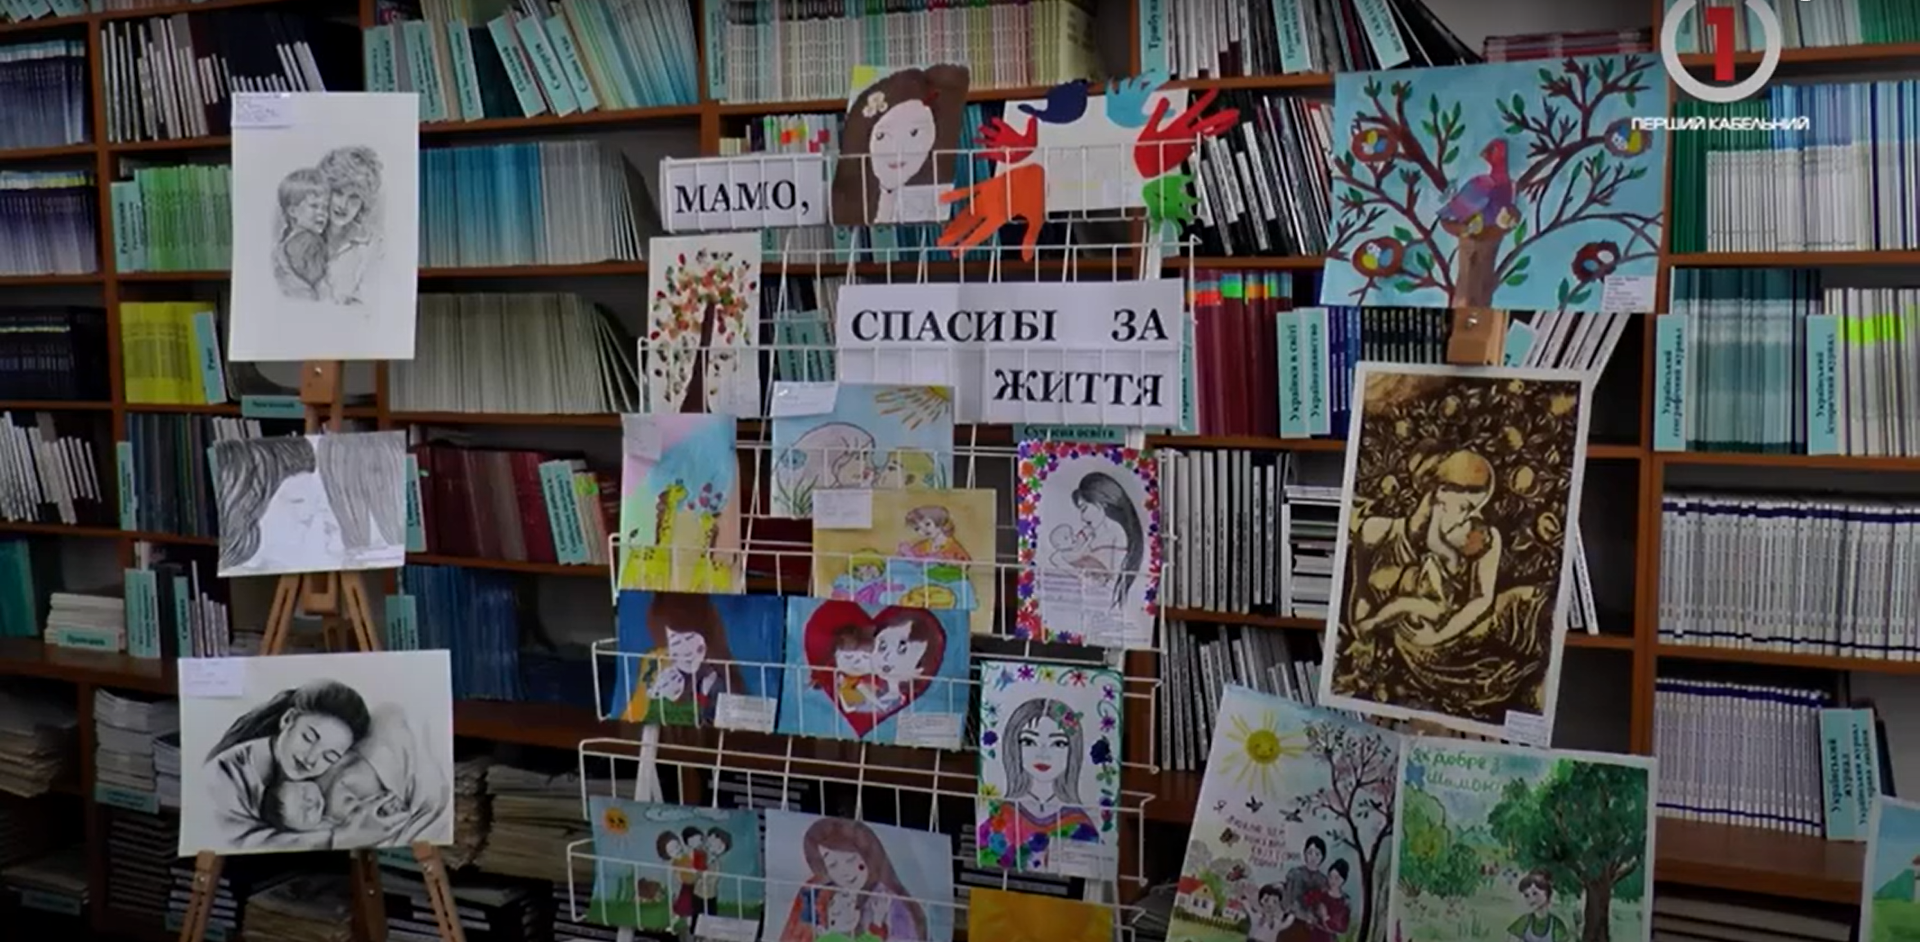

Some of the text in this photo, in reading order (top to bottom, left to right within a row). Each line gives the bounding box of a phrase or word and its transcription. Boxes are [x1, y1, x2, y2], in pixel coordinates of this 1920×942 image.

[1147, 0, 1162, 52] Трибун
[674, 179, 810, 216] МАМО,
[851, 309, 1058, 343] СПАСИБІ
[1111, 308, 1169, 343] ЗА
[1287, 324, 1298, 352] світі
[993, 368, 1164, 407] ЖИТТЯ
[1310, 323, 1322, 417] Українознавство
[1662, 350, 1673, 414] Український
[1673, 327, 1685, 437] географічний журнал
[1815, 351, 1826, 417] Український
[1825, 333, 1837, 435] історичний журнал
[1852, 723, 1862, 760] журнал
[1829, 739, 1842, 813] Український
[1842, 753, 1854, 798] журнал
